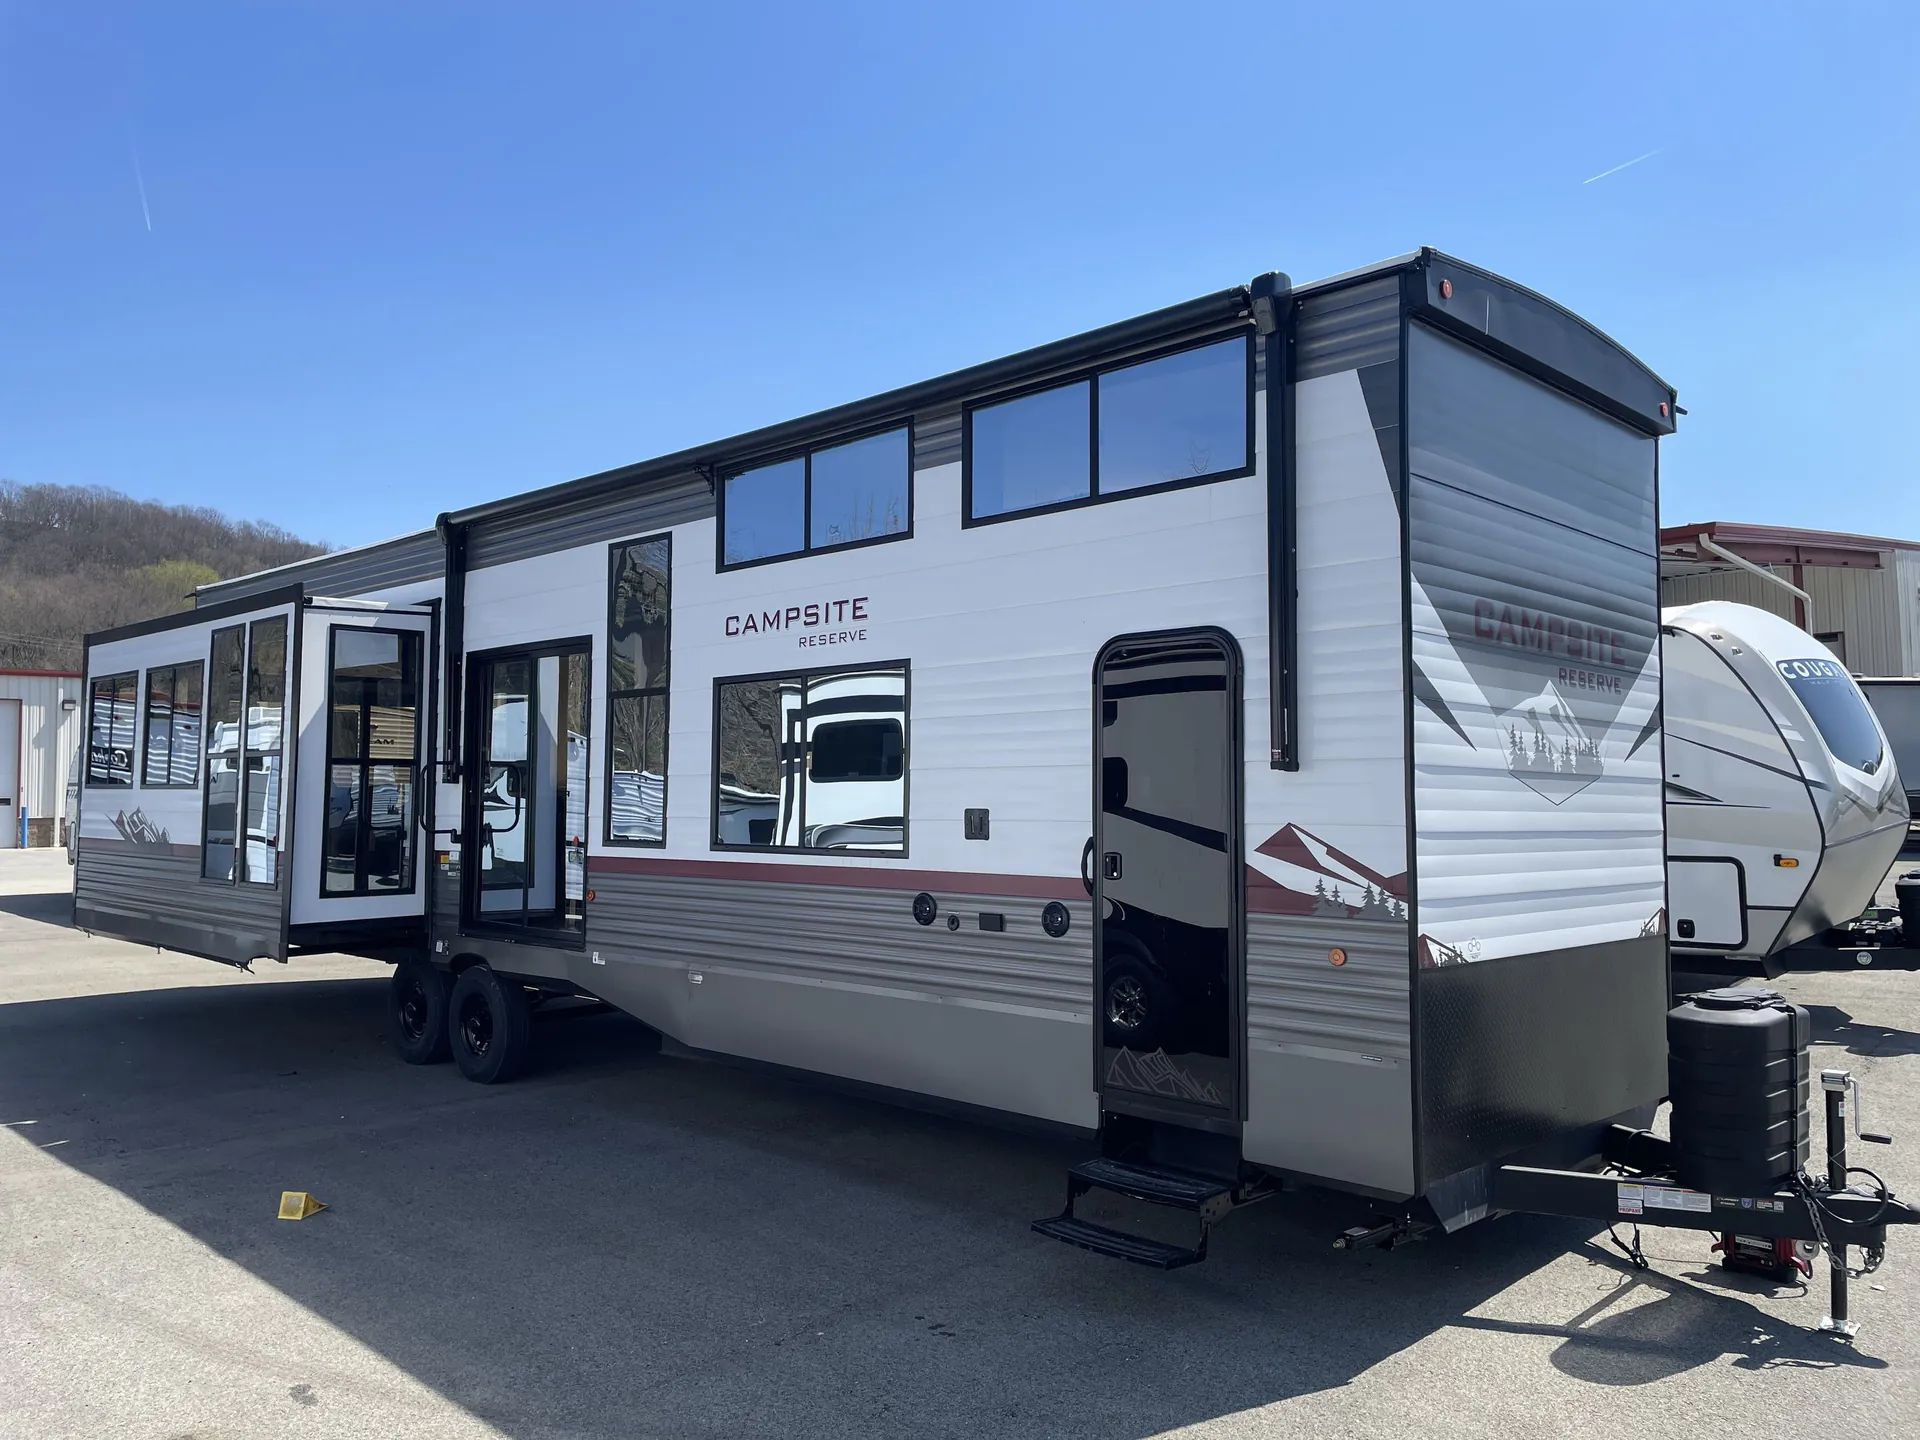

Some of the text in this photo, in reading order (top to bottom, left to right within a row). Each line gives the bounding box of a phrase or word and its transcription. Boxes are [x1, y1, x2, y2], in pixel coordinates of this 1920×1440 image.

[725, 596, 869, 637] CAMPSITE
[1474, 598, 1626, 665] CAMPSITE
[798, 629, 867, 648] RESERVE
[1558, 667, 1622, 696] RESERVE
